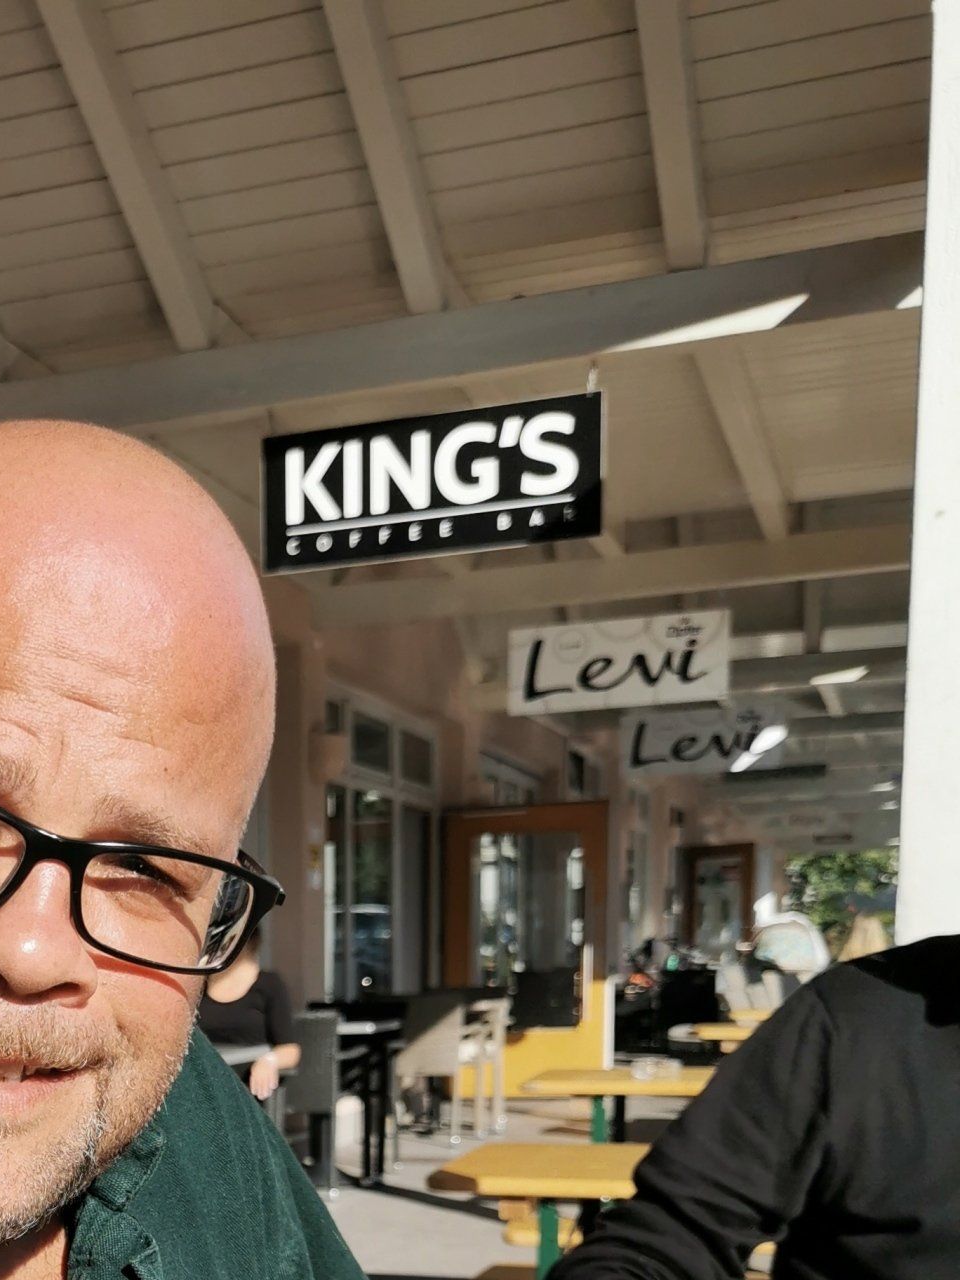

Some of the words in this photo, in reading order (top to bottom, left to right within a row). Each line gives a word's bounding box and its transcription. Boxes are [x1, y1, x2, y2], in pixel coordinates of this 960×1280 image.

[285, 411, 580, 526] KING'S
[286, 518, 454, 556] COFFEE
[497, 503, 577, 532] BAR
[524, 639, 708, 702] Levi
